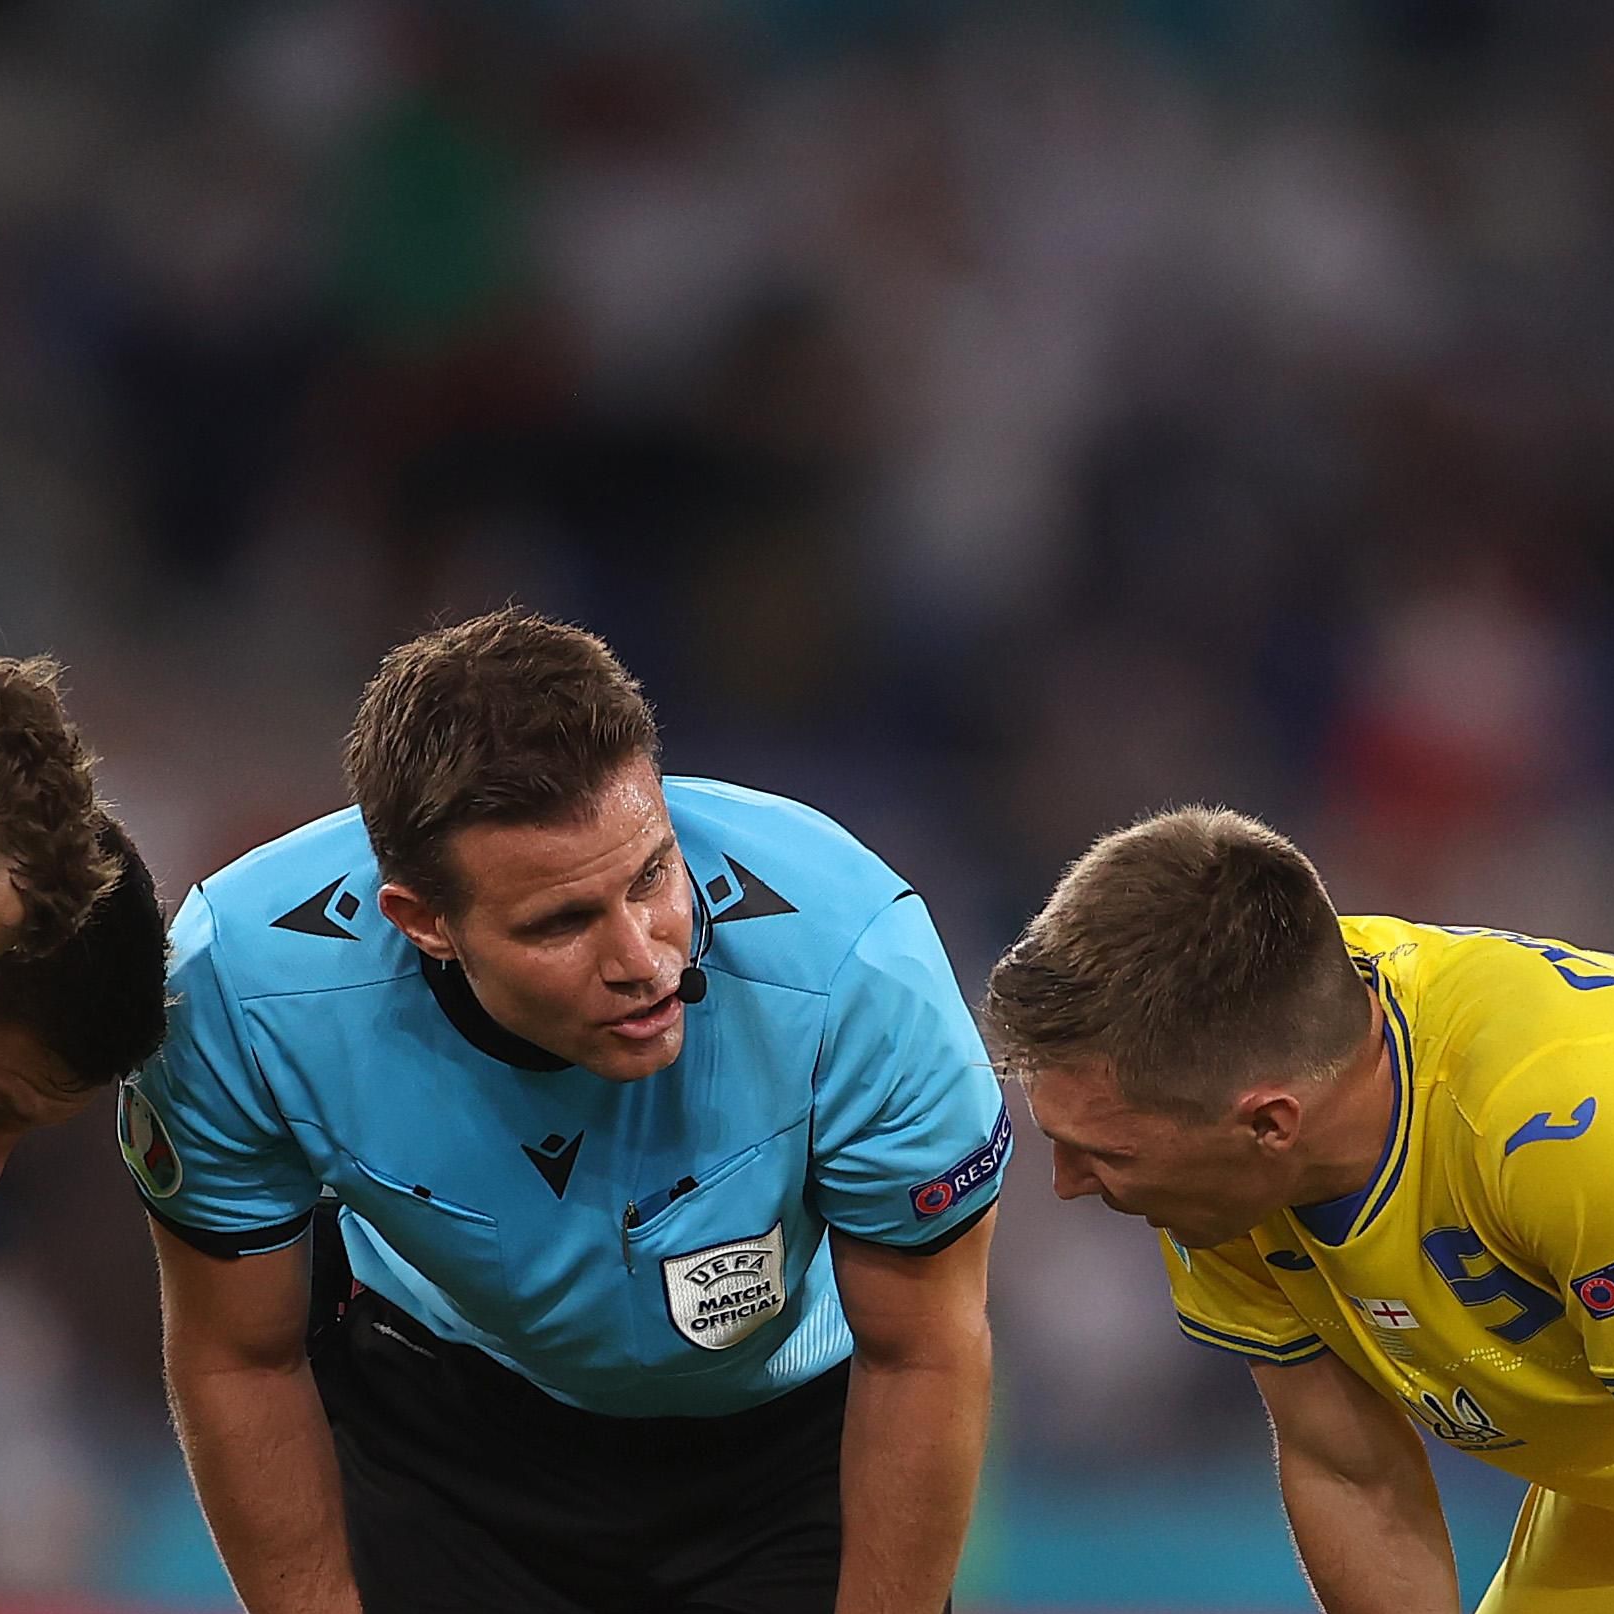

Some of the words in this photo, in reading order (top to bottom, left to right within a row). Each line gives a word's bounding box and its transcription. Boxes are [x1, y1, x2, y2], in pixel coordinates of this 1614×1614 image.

[954, 1112, 1011, 1192] RESPEC
[690, 1254, 766, 1286] UEFA
[1420, 1225, 1567, 1345] 5
[690, 1296, 782, 1331] OFFICIAL
[698, 1280, 771, 1313] MATCH
